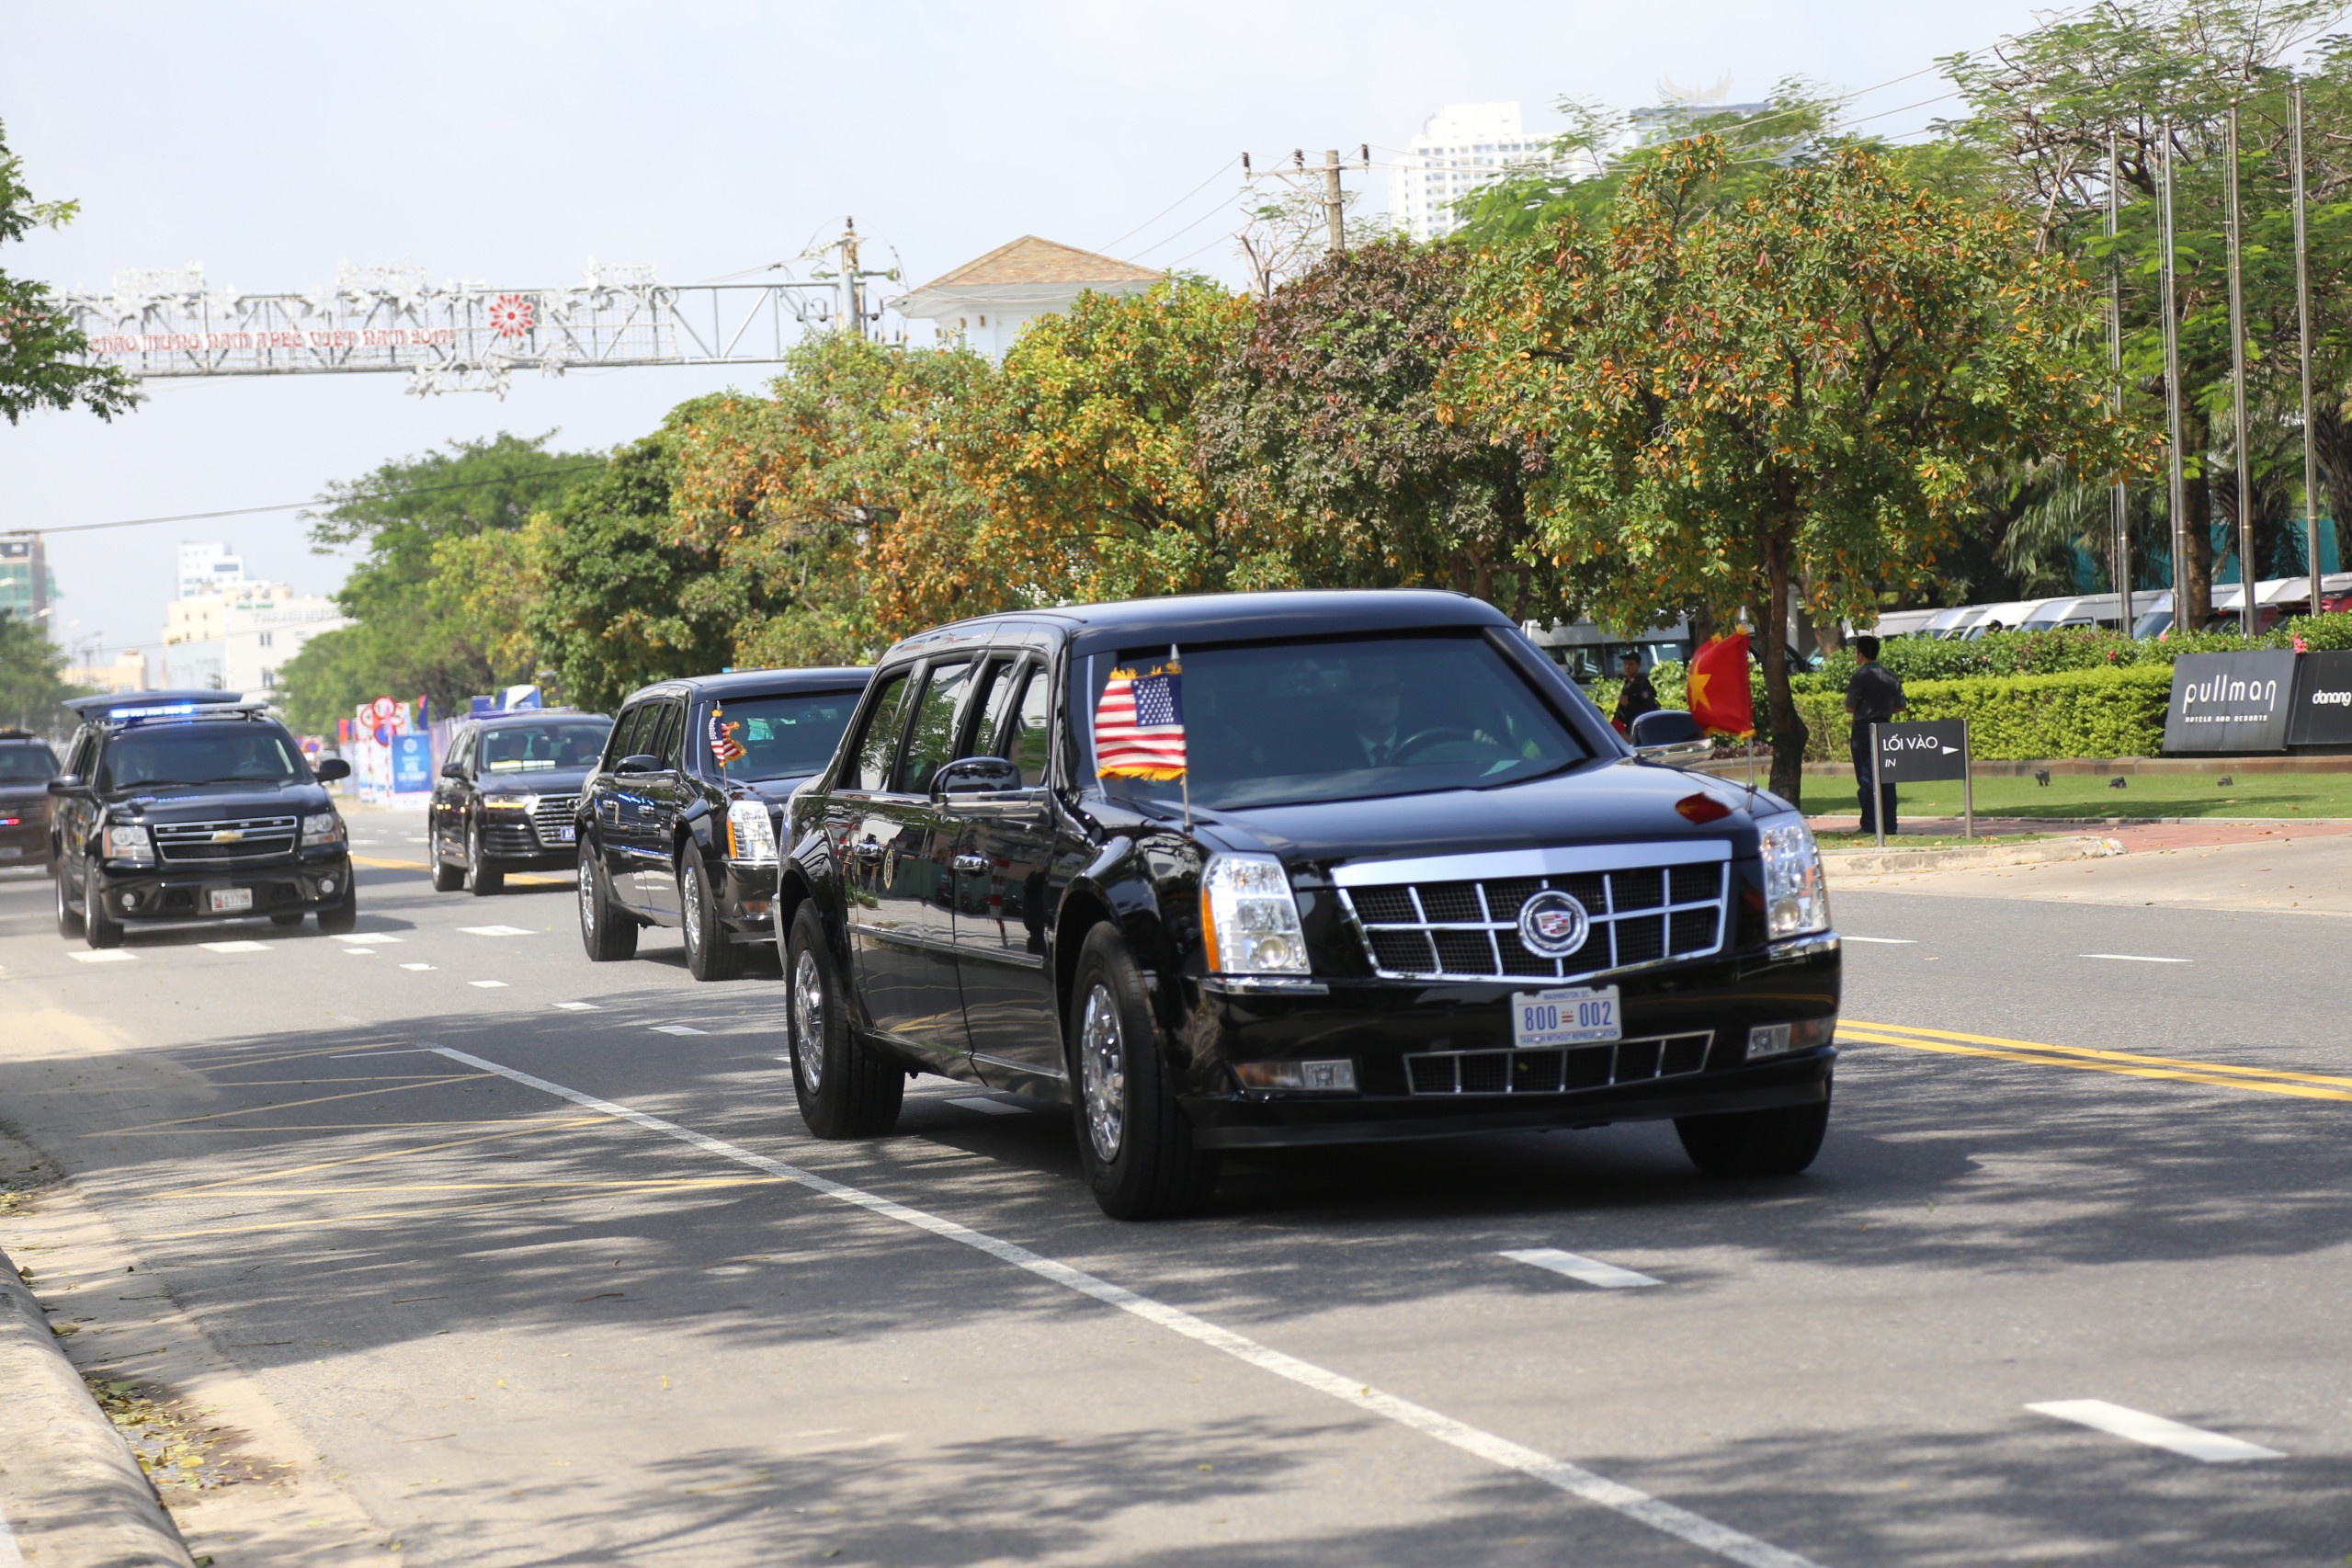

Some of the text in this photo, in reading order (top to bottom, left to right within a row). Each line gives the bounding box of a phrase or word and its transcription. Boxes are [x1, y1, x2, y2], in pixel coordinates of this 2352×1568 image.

[256, 331, 303, 348] APEC
[2183, 675, 2277, 714] pullman
[2312, 689, 2352, 707] danang
[1882, 733, 1938, 751] LỐI VÀO
[1884, 758, 1897, 767] IN
[1524, 1001, 1612, 1031] 800 002
